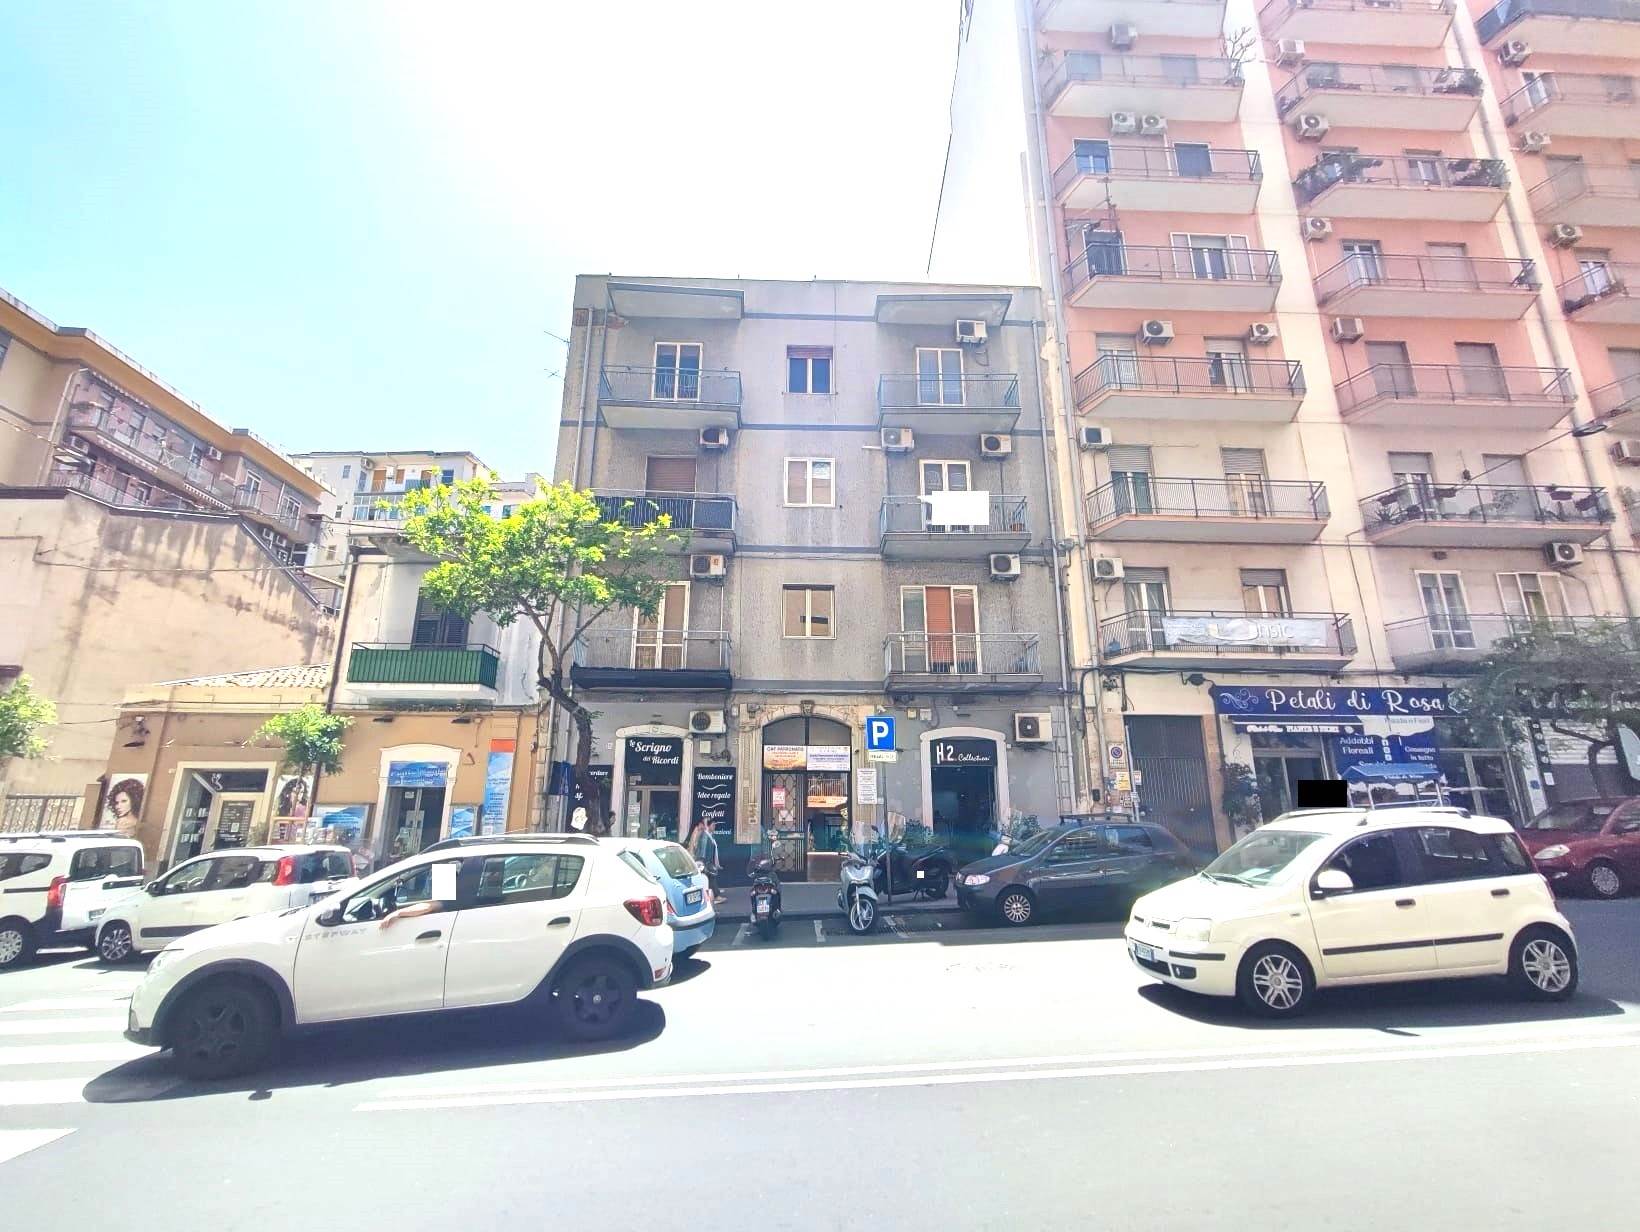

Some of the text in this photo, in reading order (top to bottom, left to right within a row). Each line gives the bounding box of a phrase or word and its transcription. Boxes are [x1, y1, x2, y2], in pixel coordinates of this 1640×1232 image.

[1265, 688, 1445, 713] Petali di Rosa
[871, 720, 889, 746] P
[1340, 737, 1374, 745] Addobbi
[635, 741, 672, 755] Scrigno
[1342, 746, 1374, 755] Floreali
[651, 755, 680, 765] Ricordi
[711, 791, 731, 801] regalo
[701, 809, 725, 818] Confetti
